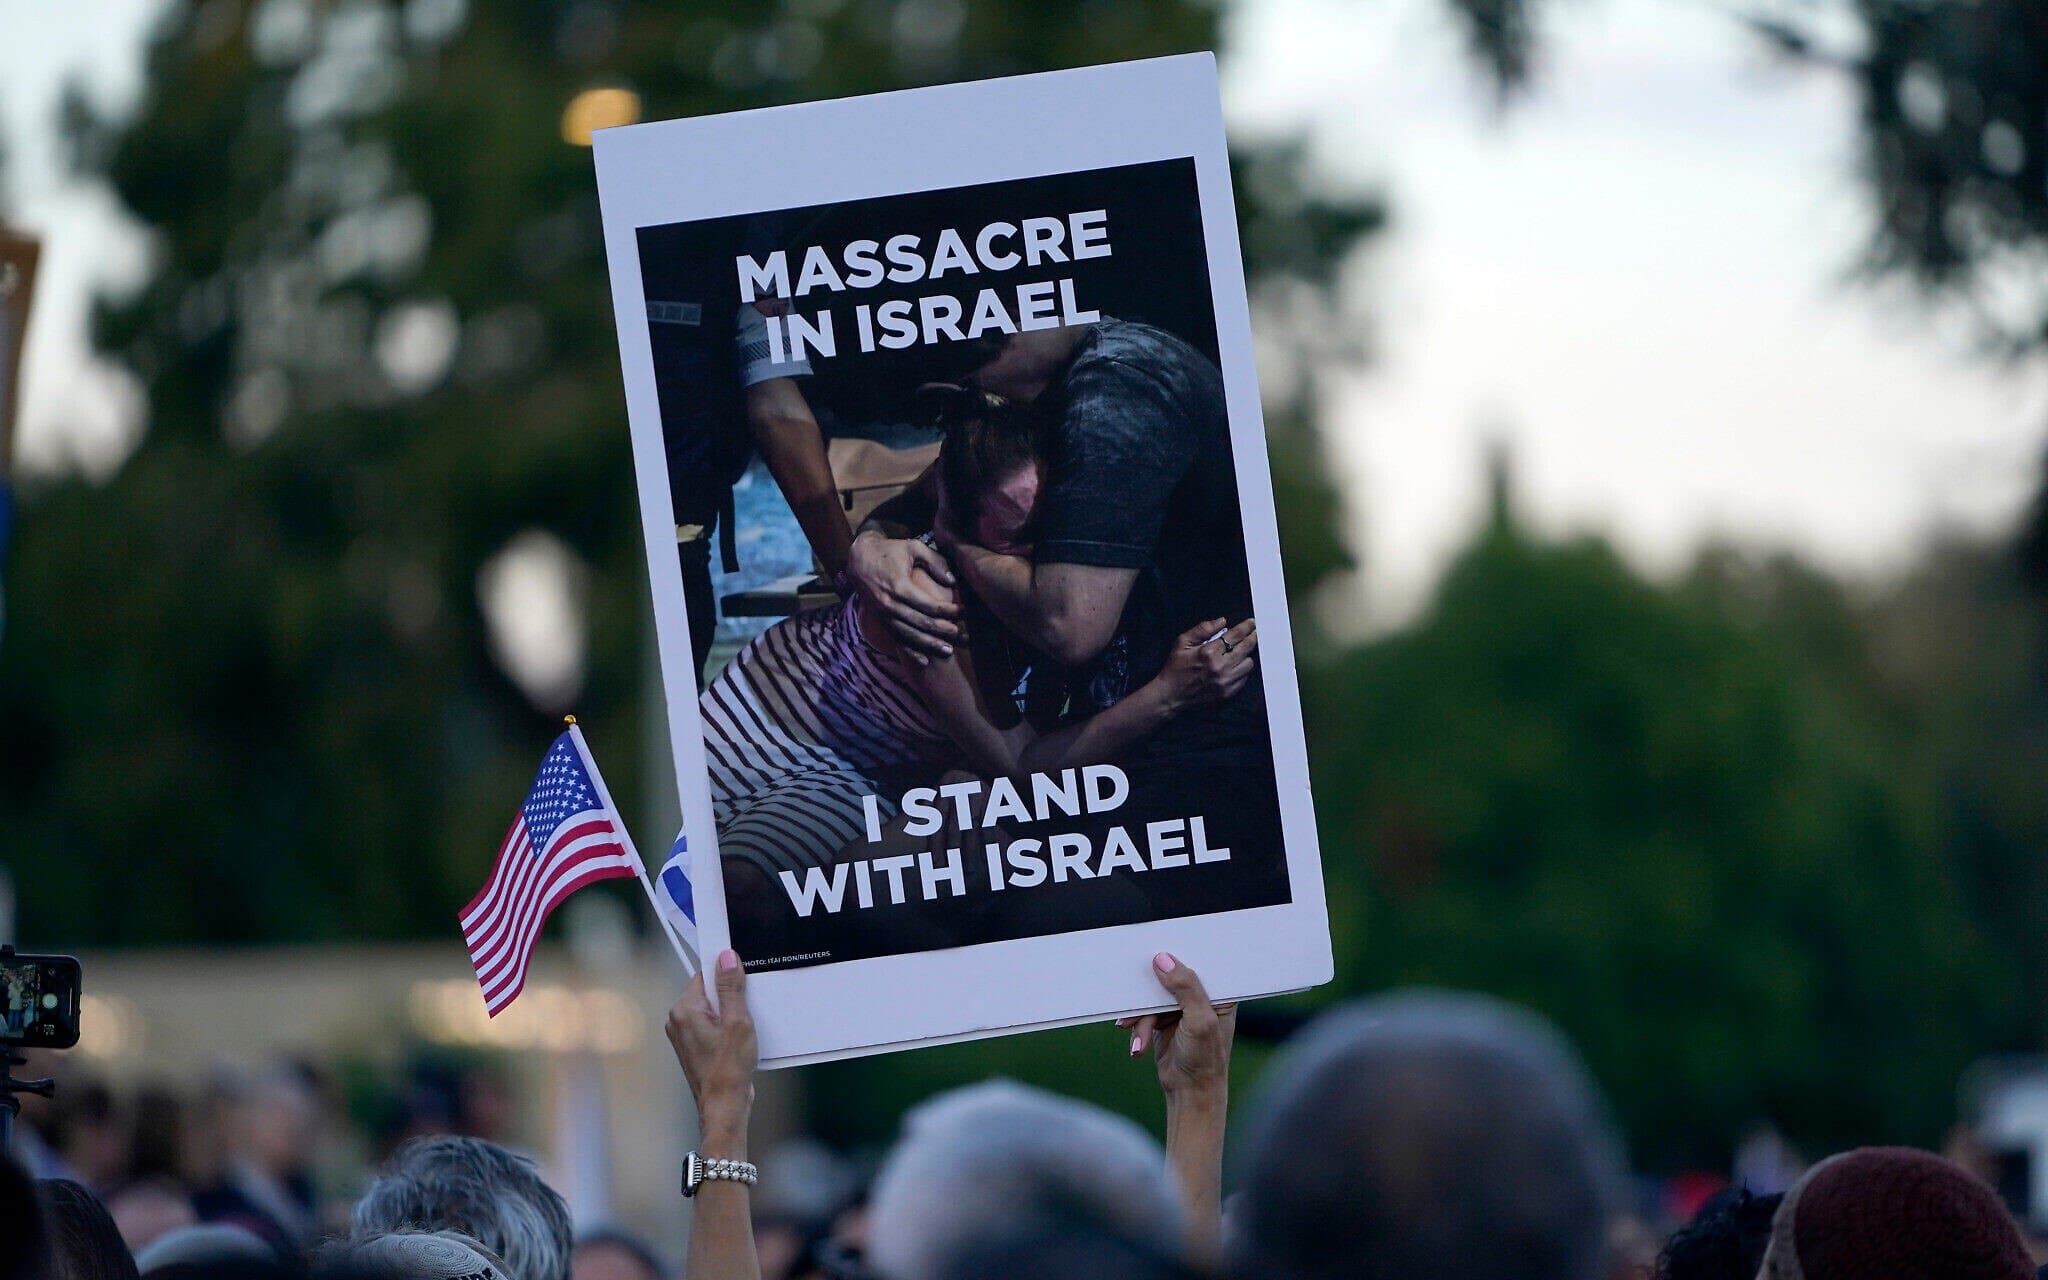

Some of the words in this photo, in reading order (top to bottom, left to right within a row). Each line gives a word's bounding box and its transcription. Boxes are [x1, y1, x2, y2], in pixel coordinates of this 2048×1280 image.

[737, 210, 1111, 302] MASSACRE
[766, 310, 836, 364] IN
[856, 279, 1100, 352] ISRAEL
[863, 795, 881, 842] I
[902, 765, 1129, 836] STAND
[779, 848, 965, 916] WITH
[986, 816, 1230, 890] ISRAEL
